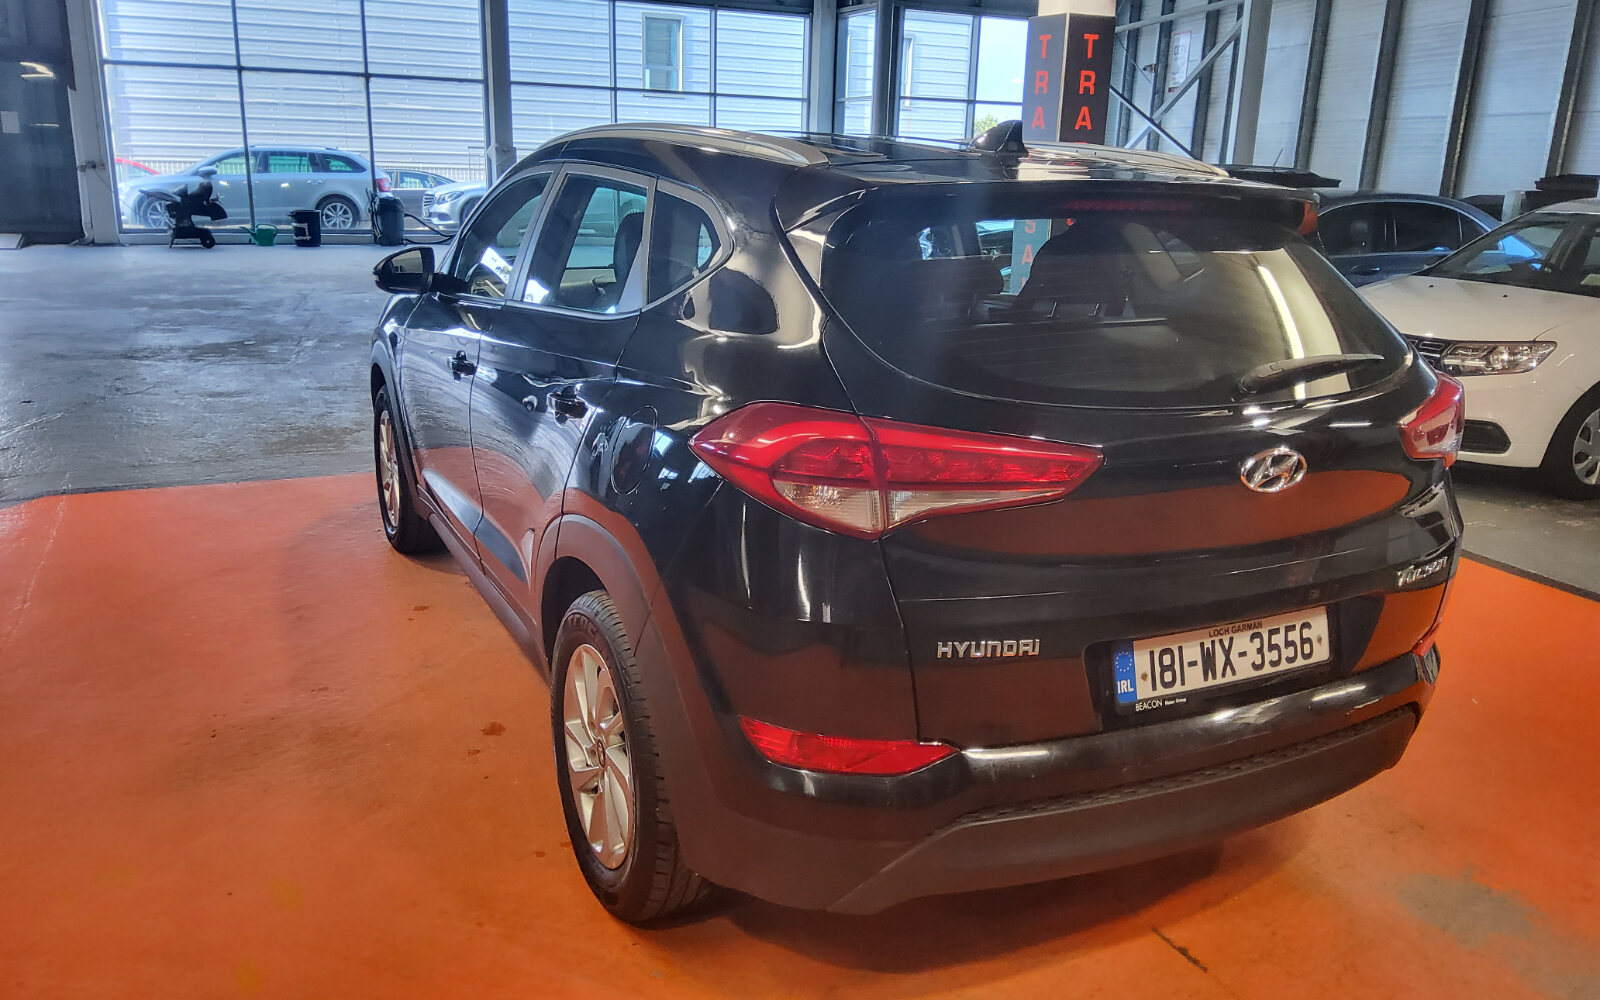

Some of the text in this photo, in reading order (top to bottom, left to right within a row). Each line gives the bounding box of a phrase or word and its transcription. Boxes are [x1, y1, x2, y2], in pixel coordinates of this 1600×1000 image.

[1074, 33, 1099, 144] TRA
[1208, 621, 1263, 638] LOCH GARMAN
[937, 639, 1040, 659] HYUNDAI
[1149, 621, 1314, 692] 181-WX-3556
[1117, 679, 1134, 694] IRL
[1135, 698, 1163, 712] BEACON
